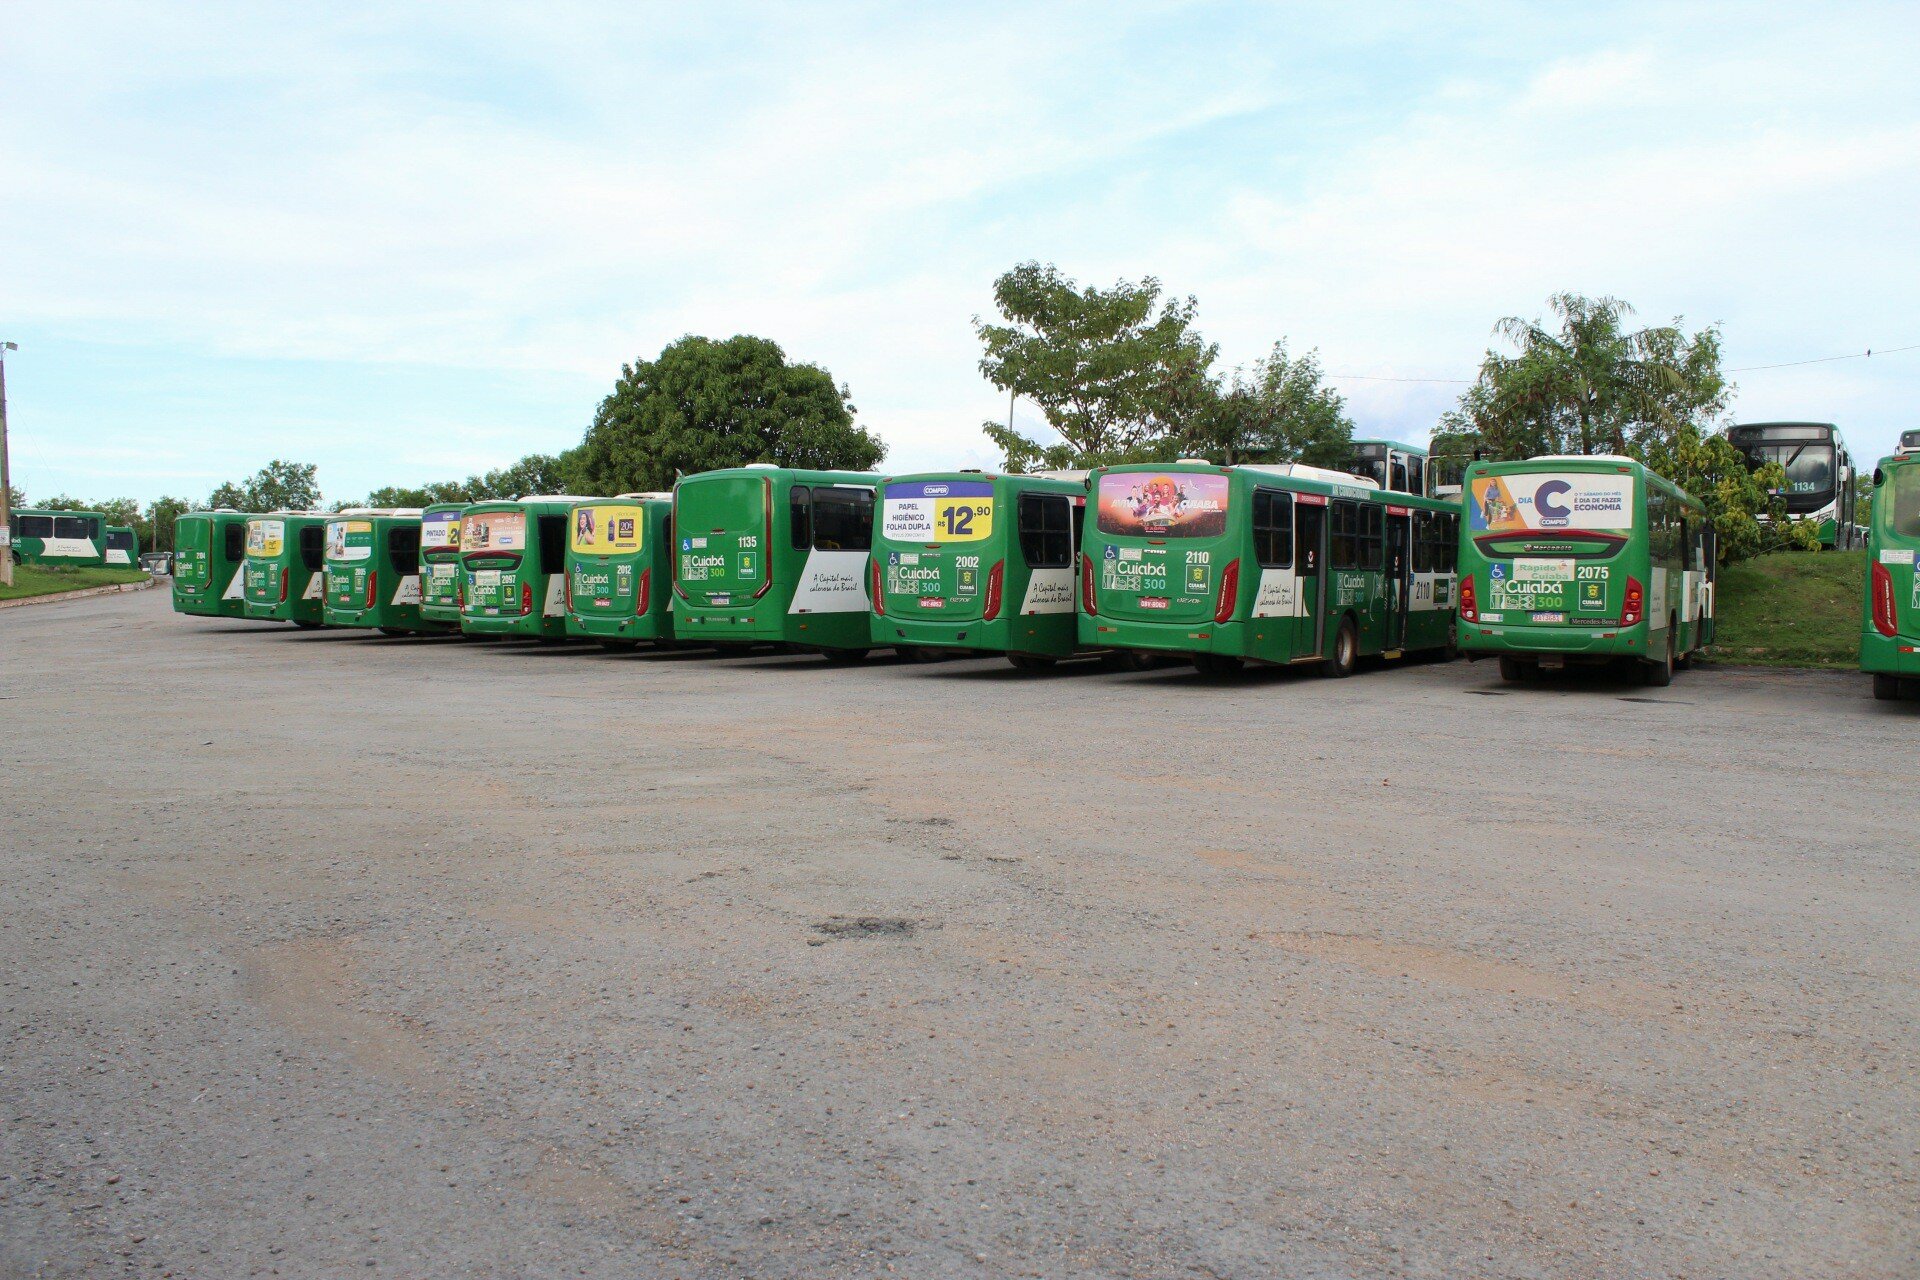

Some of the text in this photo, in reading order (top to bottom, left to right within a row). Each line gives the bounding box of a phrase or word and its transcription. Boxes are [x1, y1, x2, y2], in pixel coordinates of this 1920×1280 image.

[1793, 482, 1815, 492] 1134
[1534, 480, 1572, 517] C
[892, 512, 925, 520] HIGIÊNICO
[738, 536, 756, 548] 1135
[692, 555, 724, 566] Cuiabá
[956, 556, 979, 568] 2002
[1186, 551, 1209, 564] 2110
[617, 565, 632, 574] 2012
[710, 568, 724, 577] 300
[1118, 560, 1166, 576] Cuiabá
[1520, 563, 1557, 572] Rápido
[1578, 566, 1609, 579] 2075
[502, 574, 516, 584] 2097
[582, 573, 609, 584] Cuiabá
[814, 574, 818, 582] A
[820, 574, 840, 584] Capital
[900, 567, 940, 580] Cuiabá
[1531, 572, 1569, 580] Cuiabá
[1144, 579, 1166, 590] 300
[1344, 574, 1364, 588] Cuiabá
[810, 582, 858, 592] calorosa do Brasil
[922, 582, 940, 592] 300
[1034, 582, 1038, 592] A
[1039, 582, 1056, 594] Capital
[1263, 584, 1266, 593] A
[1268, 584, 1281, 596] Capital
[1416, 581, 1430, 600] 2110
[1506, 580, 1562, 594] Cuiabá
[1030, 592, 1072, 604] calorosa do Brasil
[1260, 596, 1275, 606] calorosa
[1282, 595, 1293, 605] Brasil
[1537, 597, 1562, 608] 300
